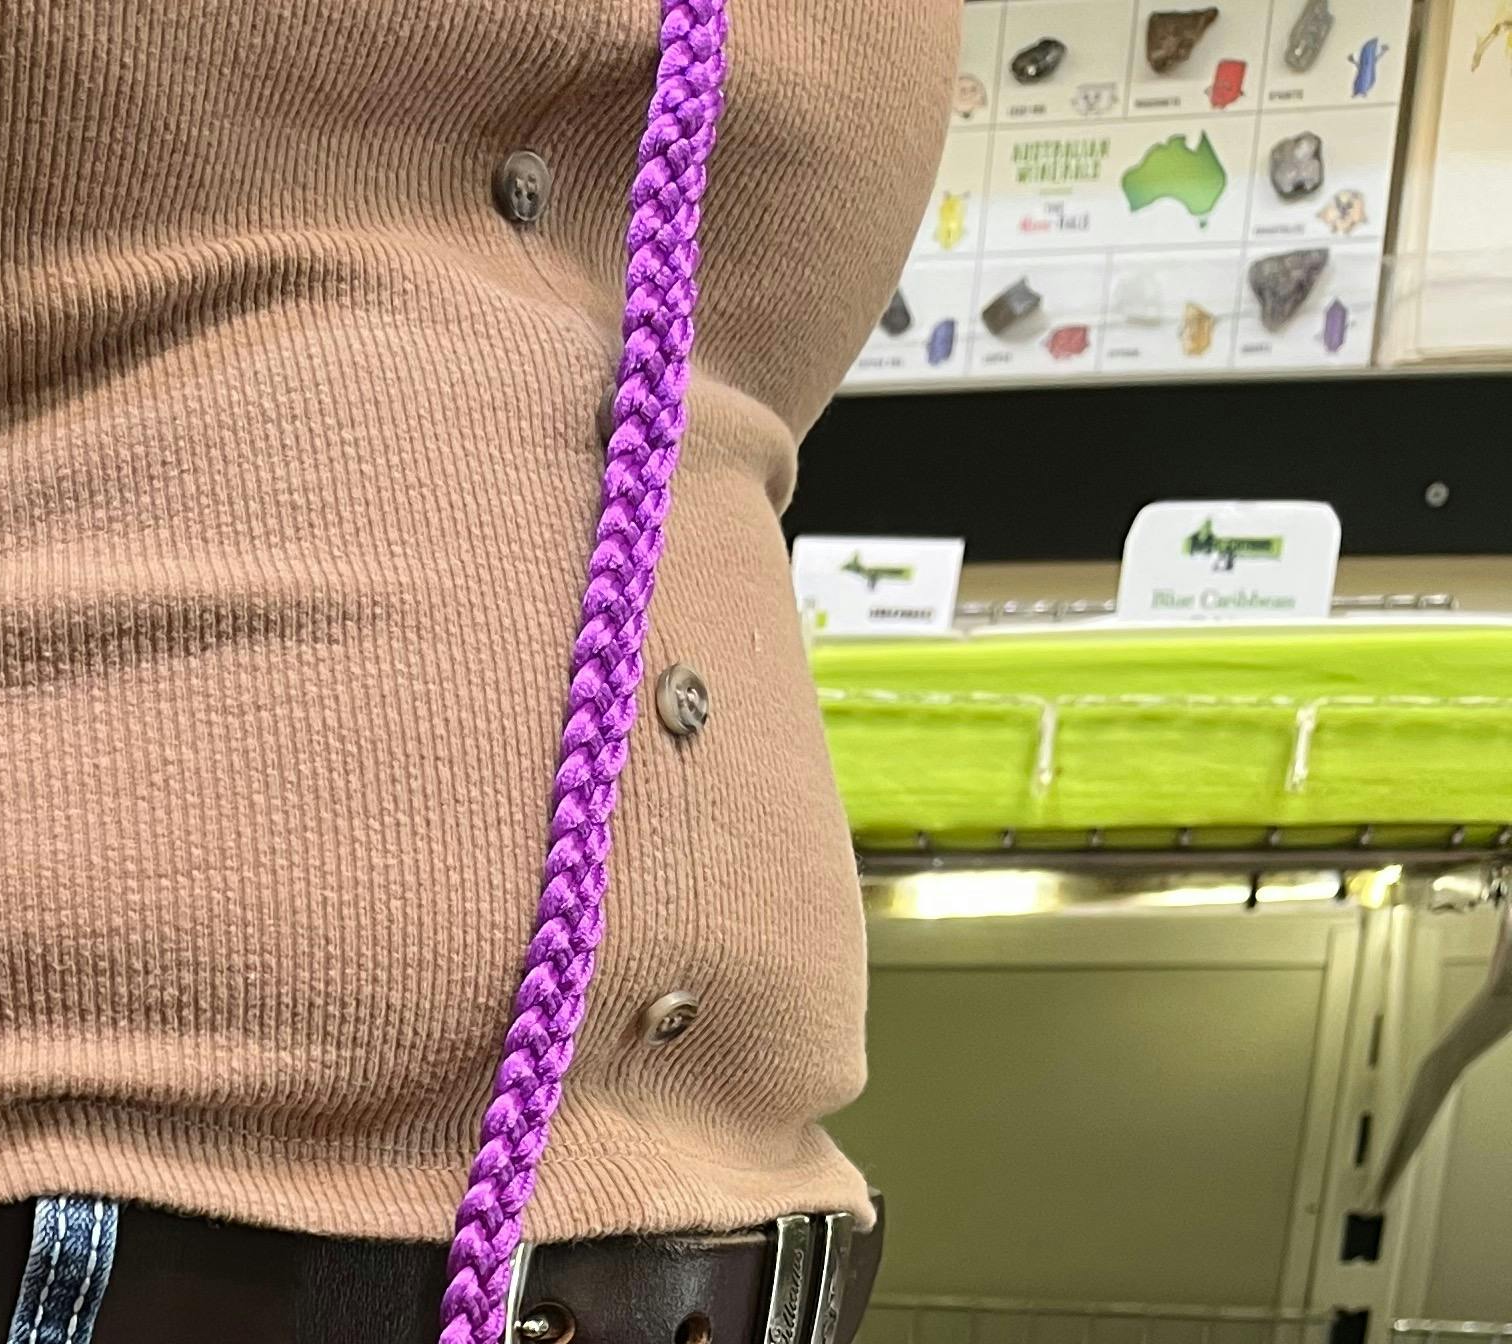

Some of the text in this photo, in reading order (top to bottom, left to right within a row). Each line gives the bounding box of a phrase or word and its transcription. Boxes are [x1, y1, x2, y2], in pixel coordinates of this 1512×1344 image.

[1013, 139, 1110, 161] AUSTRALIAN
[1151, 588, 1296, 610] Blue Caribbean
